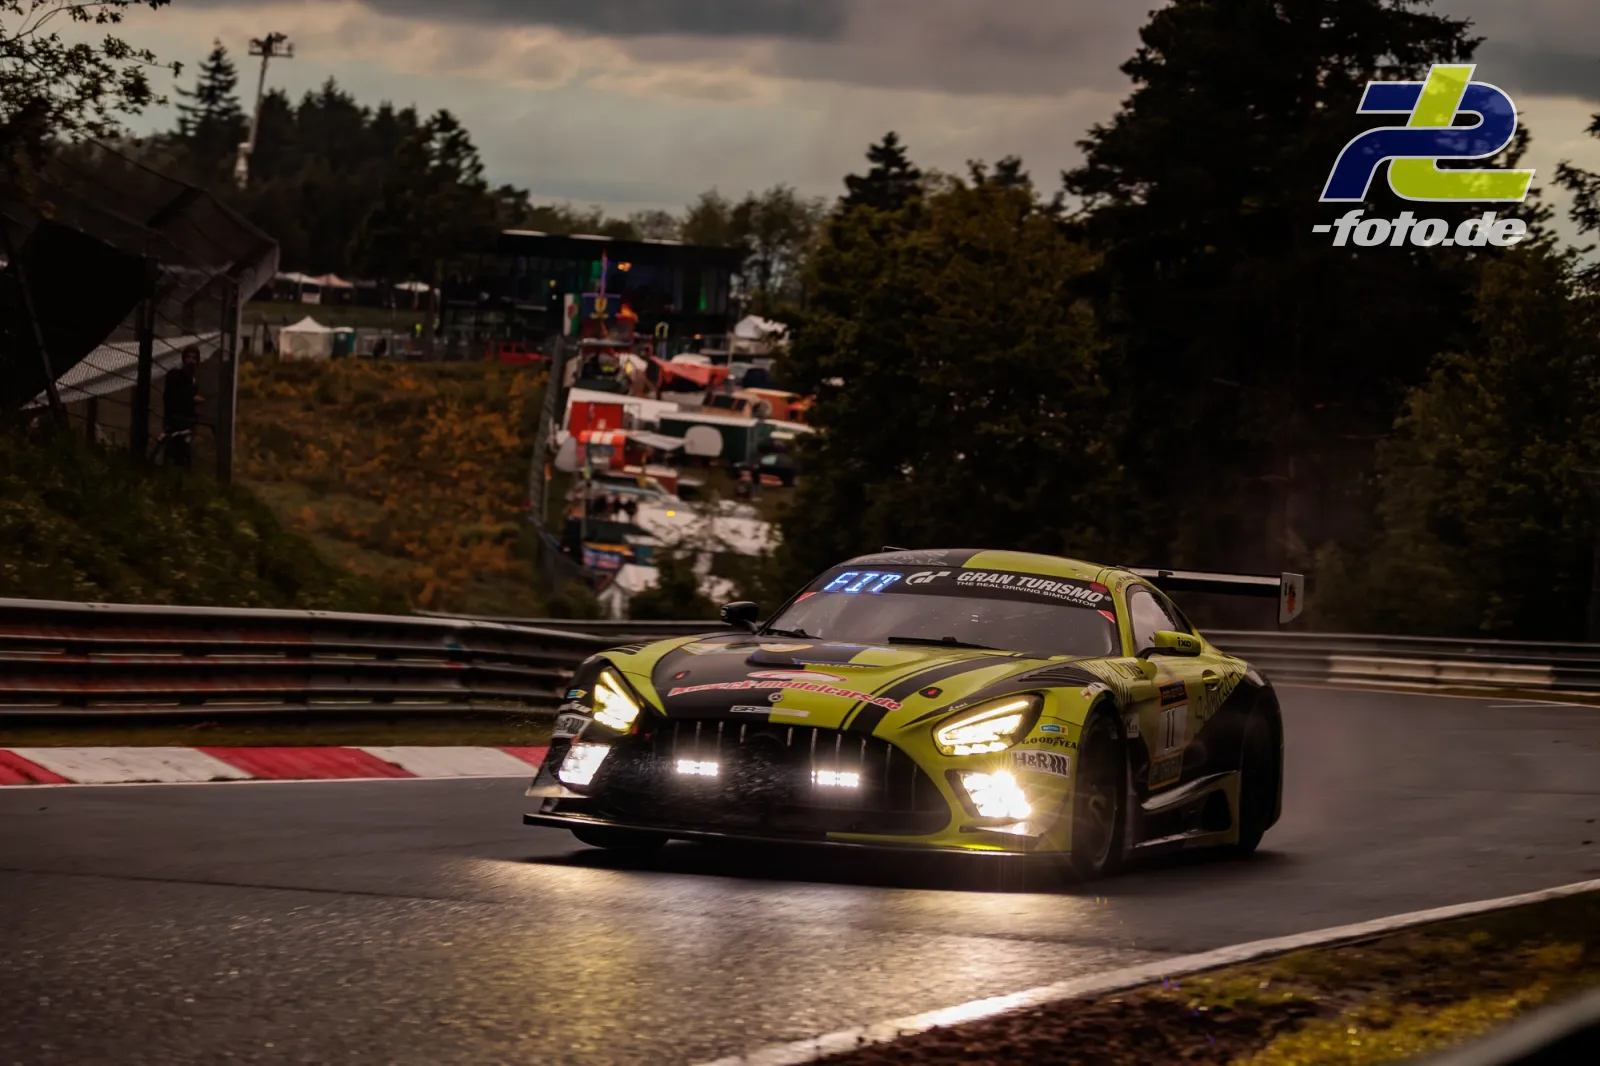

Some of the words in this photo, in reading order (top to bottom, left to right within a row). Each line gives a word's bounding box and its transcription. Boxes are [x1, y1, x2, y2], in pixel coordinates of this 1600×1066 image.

[822, 571, 904, 594] FIT
[956, 571, 1015, 585] GRAN
[1016, 576, 1104, 603] TURISMO
[1002, 584, 1040, 595] DRIVING
[1042, 591, 1097, 608] SIMULATOR
[1176, 636, 1191, 647] ixo
[1165, 708, 1175, 749] 11
[1012, 751, 1048, 769] H&R
